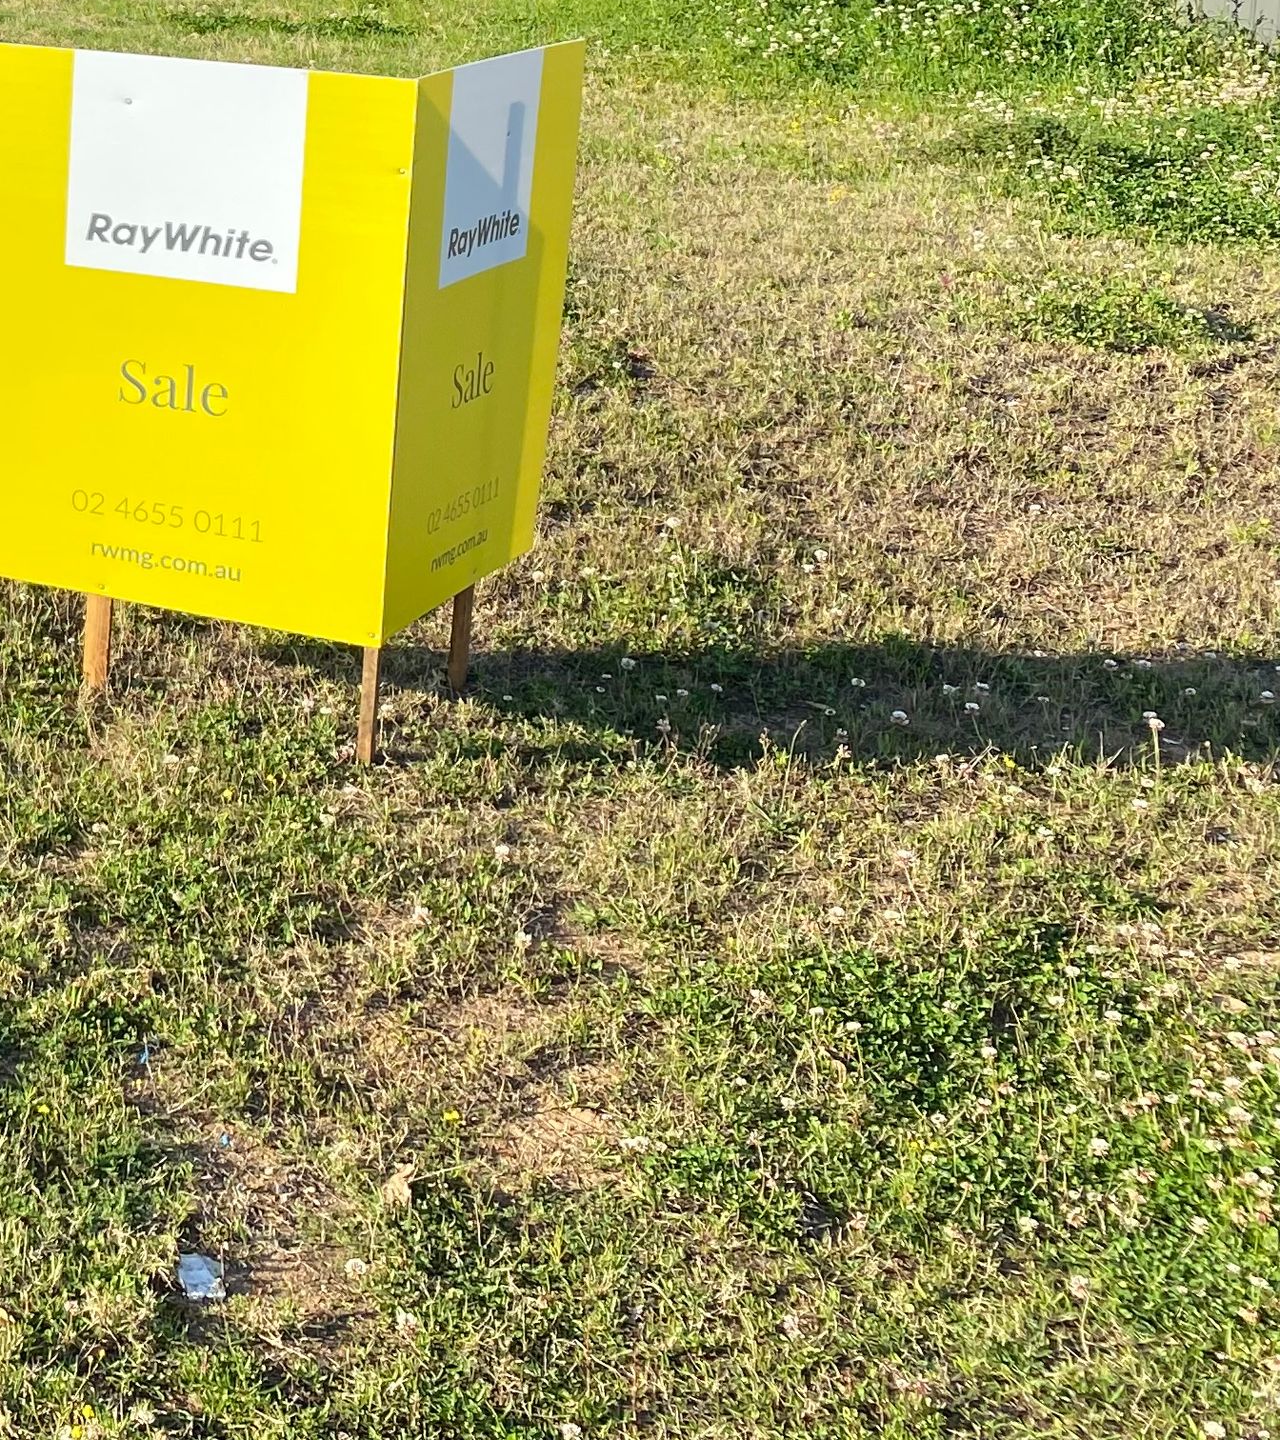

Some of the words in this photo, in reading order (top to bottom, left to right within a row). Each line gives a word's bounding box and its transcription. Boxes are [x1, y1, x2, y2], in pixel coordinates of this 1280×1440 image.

[119, 359, 229, 417] Sale
[451, 351, 495, 409] Sale
[71, 488, 106, 516] 02
[114, 496, 184, 529] 4655
[193, 509, 265, 543] 0111
[427, 507, 442, 536] 02
[443, 491, 471, 523] 4655
[472, 475, 500, 509] 0111
[91, 541, 242, 583] rwmg.com.au
[431, 529, 489, 573] rwmg.com.au
